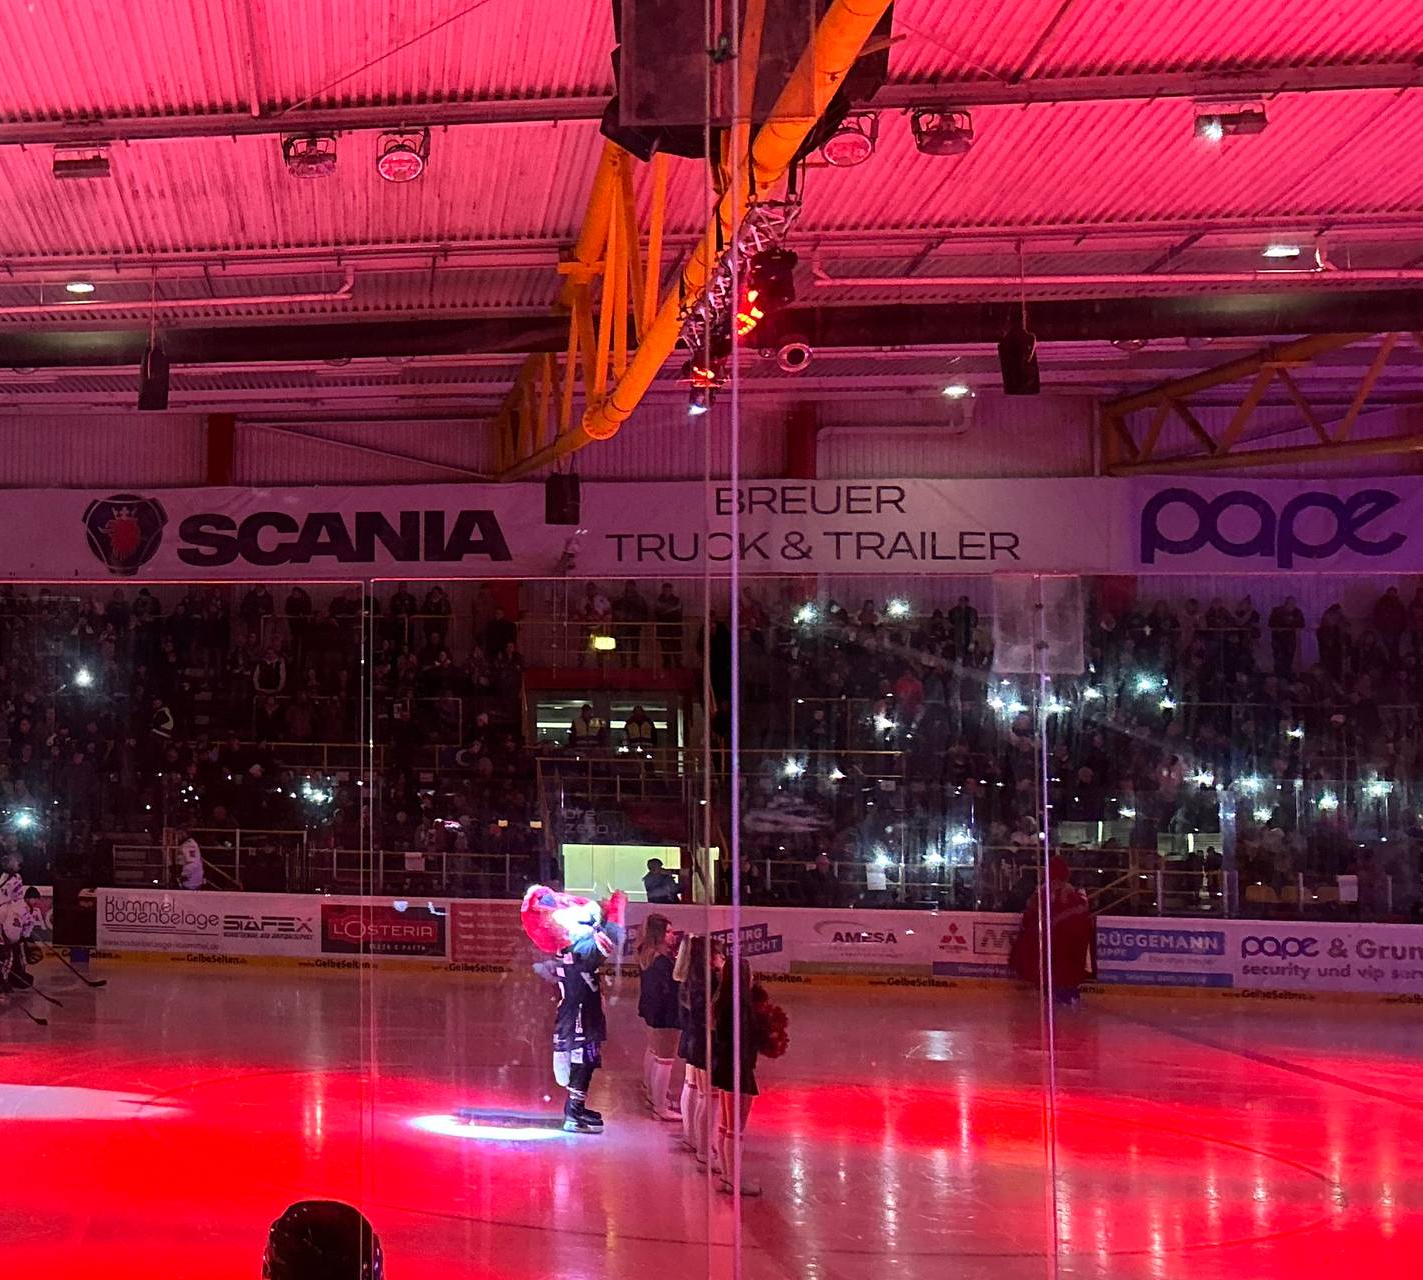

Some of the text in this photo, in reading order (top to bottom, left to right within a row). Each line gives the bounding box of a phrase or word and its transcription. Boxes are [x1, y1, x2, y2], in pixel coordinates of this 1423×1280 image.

[715, 484, 906, 516] BREUER
[178, 509, 514, 567] SCANIA
[605, 530, 1021, 563] TRUCK & TRAILER
[832, 931, 898, 944] AMESA
[1096, 931, 1218, 950] RÜGGEMANN
[1242, 962, 1311, 980] security
[1318, 963, 1351, 978] und
[1357, 965, 1384, 981] vip
